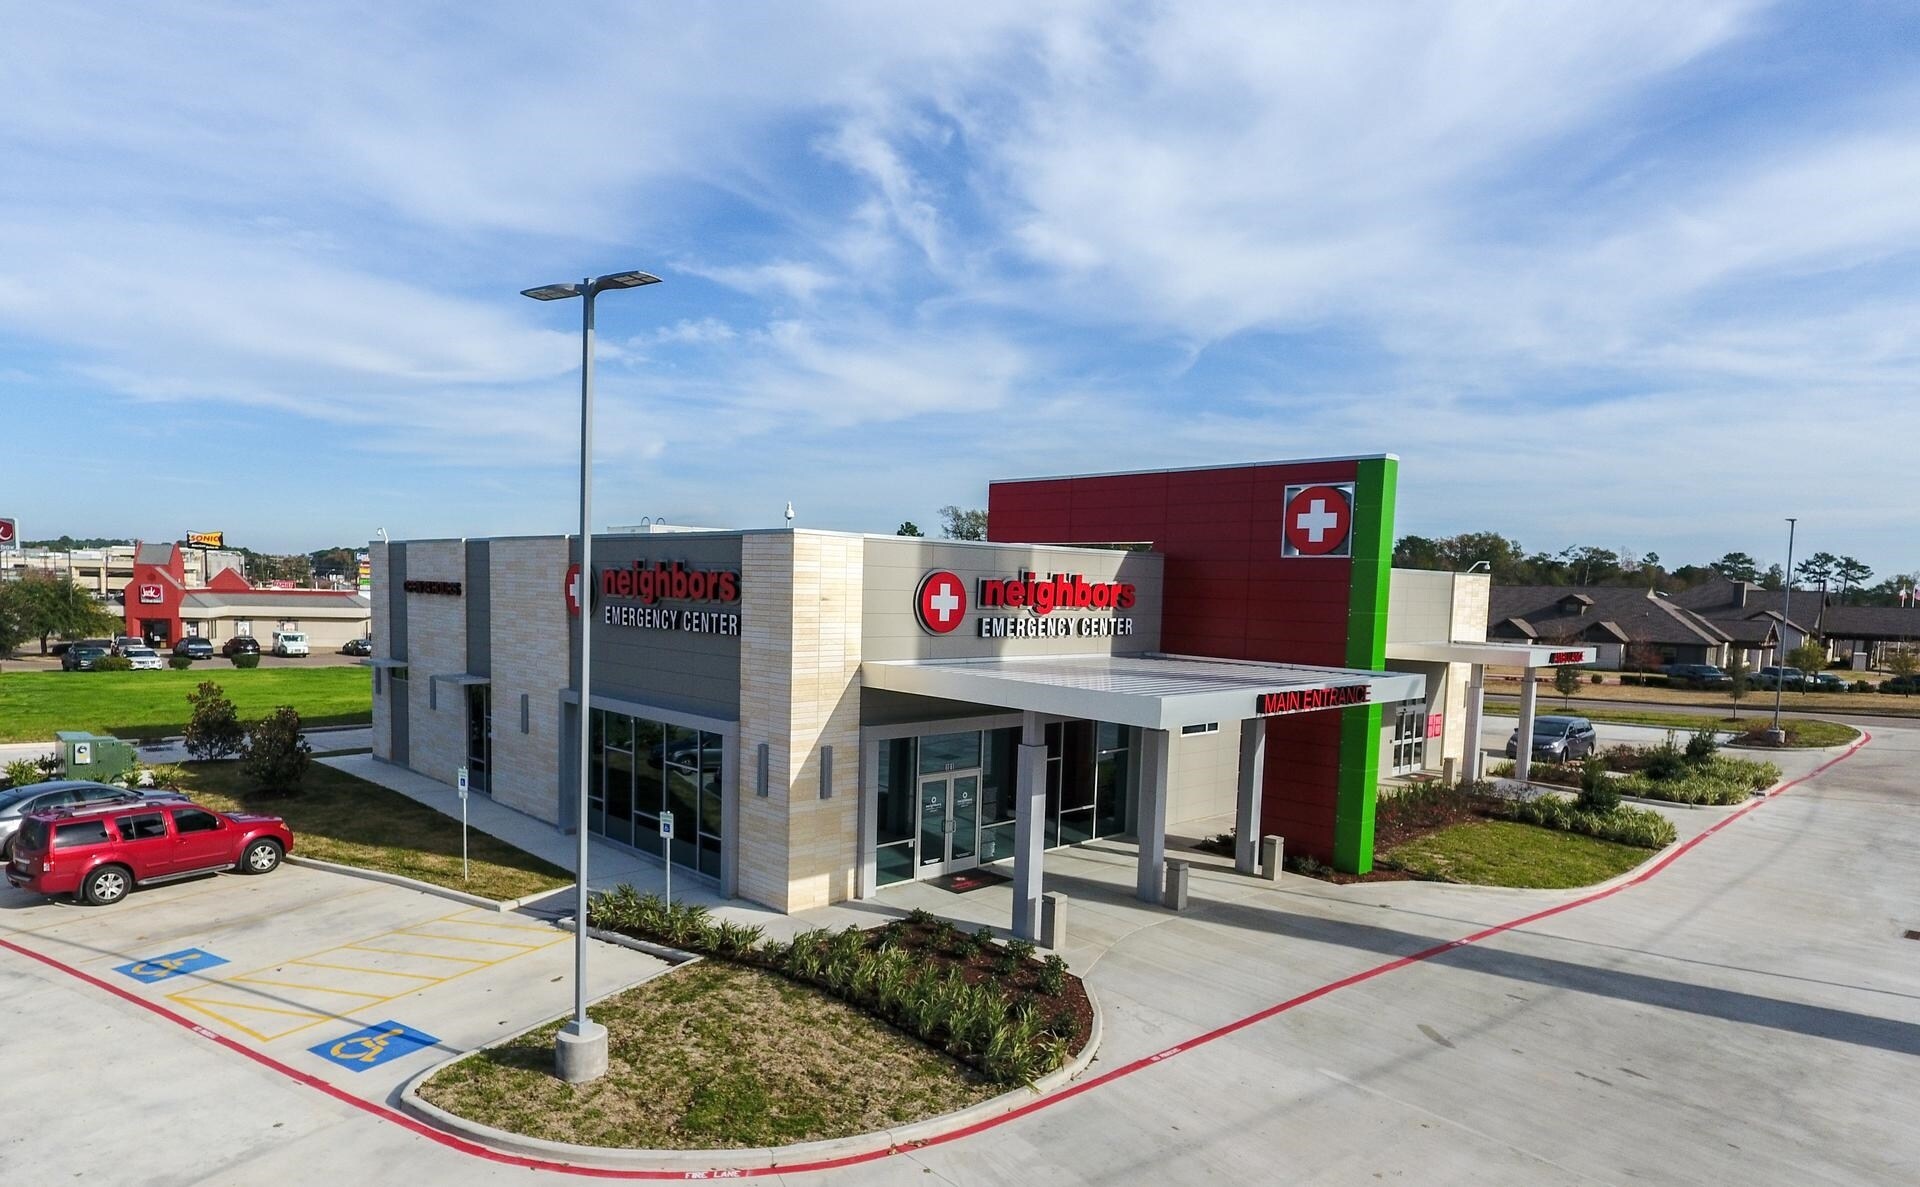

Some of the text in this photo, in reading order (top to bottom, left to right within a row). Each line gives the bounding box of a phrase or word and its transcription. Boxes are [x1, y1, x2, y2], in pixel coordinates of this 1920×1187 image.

[603, 560, 736, 605] neighbors
[983, 572, 1136, 615] neighbors
[605, 605, 738, 636] EMERGENCY CENTER
[981, 617, 1133, 637] EMERGENCY CENTER
[1264, 685, 1371, 714] MAIN ENTRANCE
[684, 1169, 741, 1179] FIRE LANE
